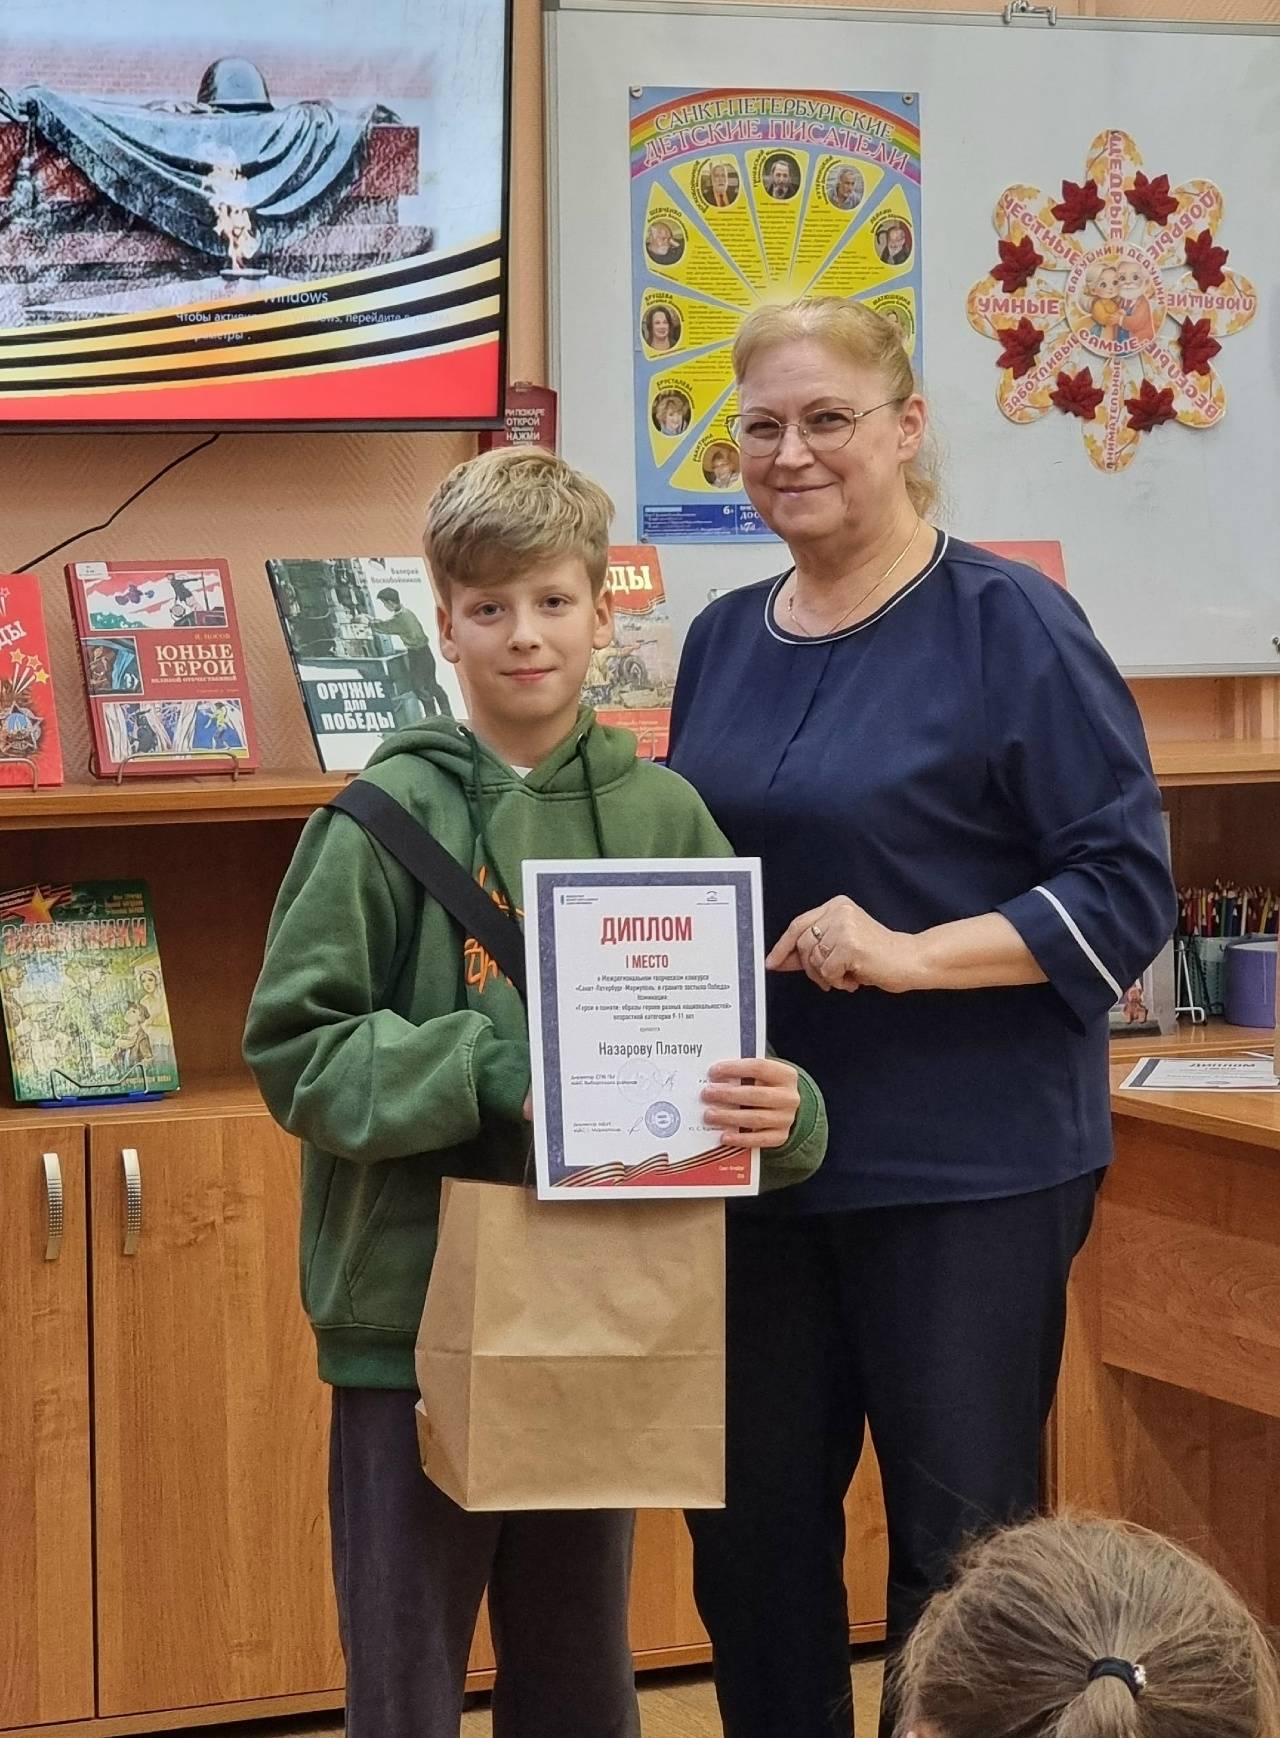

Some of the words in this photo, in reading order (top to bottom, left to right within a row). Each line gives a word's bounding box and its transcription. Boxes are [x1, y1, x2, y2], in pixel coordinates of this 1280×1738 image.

[655, 96, 895, 140] САНКТ-ПЕТЕРБУРГСКИЕ
[645, 119, 761, 167] ДЕТСКИЕ
[768, 119, 911, 172] ПИСАТЕЛИ
[1109, 134, 1123, 239] ЩЕДРЫЕ
[1003, 193, 1081, 266] ЧЕСТНЫЕ
[1147, 191, 1215, 260] ДОБРЫЕ
[1067, 245, 1112, 294] БАБУШКИ
[1115, 245, 1123, 253] И
[1127, 248, 1165, 305] ДЕДУШКИ
[978, 298, 1060, 315] УМНЫЕ
[1167, 293, 1254, 311] ЛЮБЯЩИЕ
[176, 312, 212, 323] Чтобы
[345, 311, 401, 325] перейдите
[1146, 341, 1219, 419] ВЕСЕЛЫЕ
[506, 417, 540, 426] ОТКРОЙ
[506, 432, 541, 440] НАЖМИ
[155, 644, 234, 661] ЮНЫЕ
[158, 659, 236, 677] ГЕРОИ
[316, 681, 386, 700] ОРУЖИЕ
[320, 711, 396, 731] ПОБЕДЫ
[602, 917, 692, 944] ДИПЛОМ
[632, 955, 669, 968] МЕСТО
[599, 1042, 653, 1058] Назарову
[656, 1041, 703, 1057] Платону
